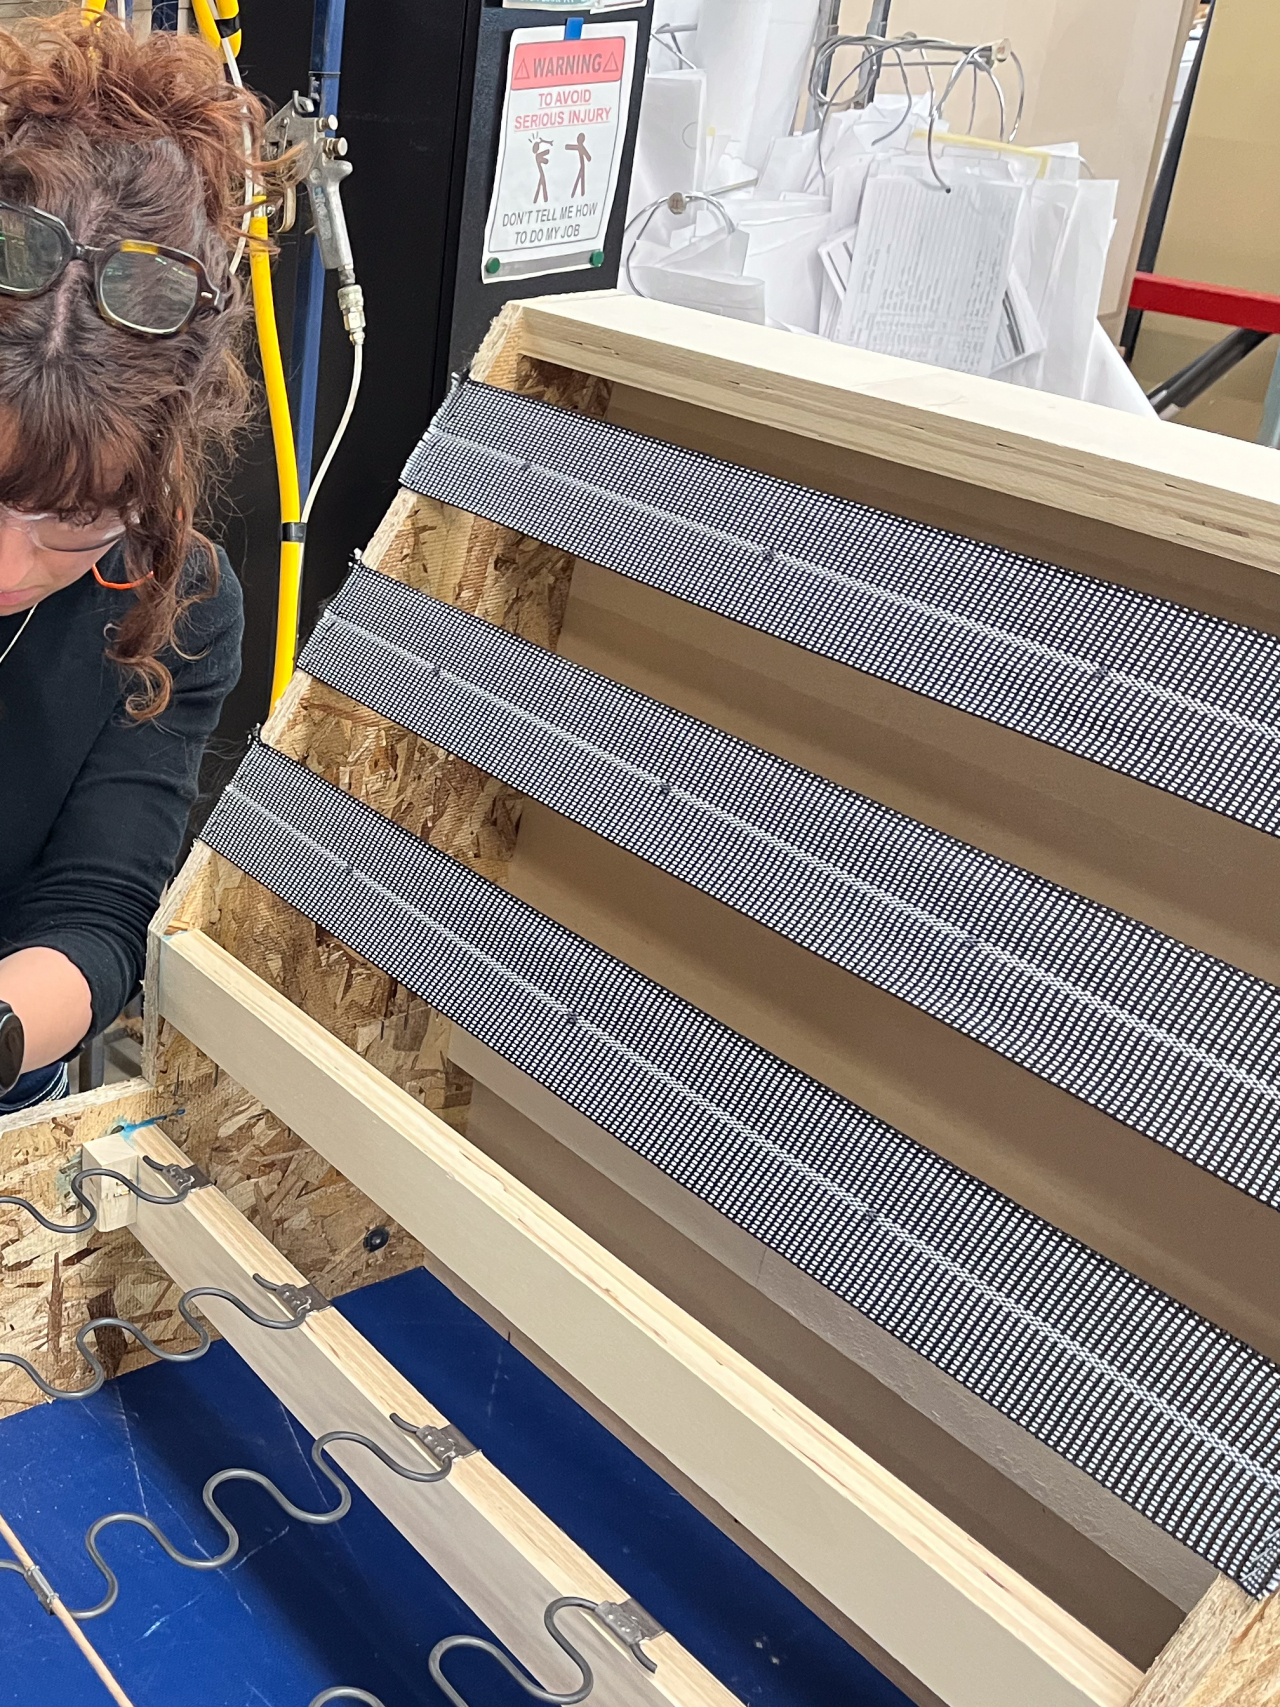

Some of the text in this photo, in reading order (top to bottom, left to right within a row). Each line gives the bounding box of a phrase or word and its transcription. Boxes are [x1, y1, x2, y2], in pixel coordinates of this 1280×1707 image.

[533, 53, 602, 78] WARNING
[538, 89, 591, 107] TO AVOID
[514, 107, 612, 130] SERIOUS INJURY
[502, 202, 598, 227] DON'T TELL ME HOW
[515, 224, 581, 245] TO DO MY JOB
